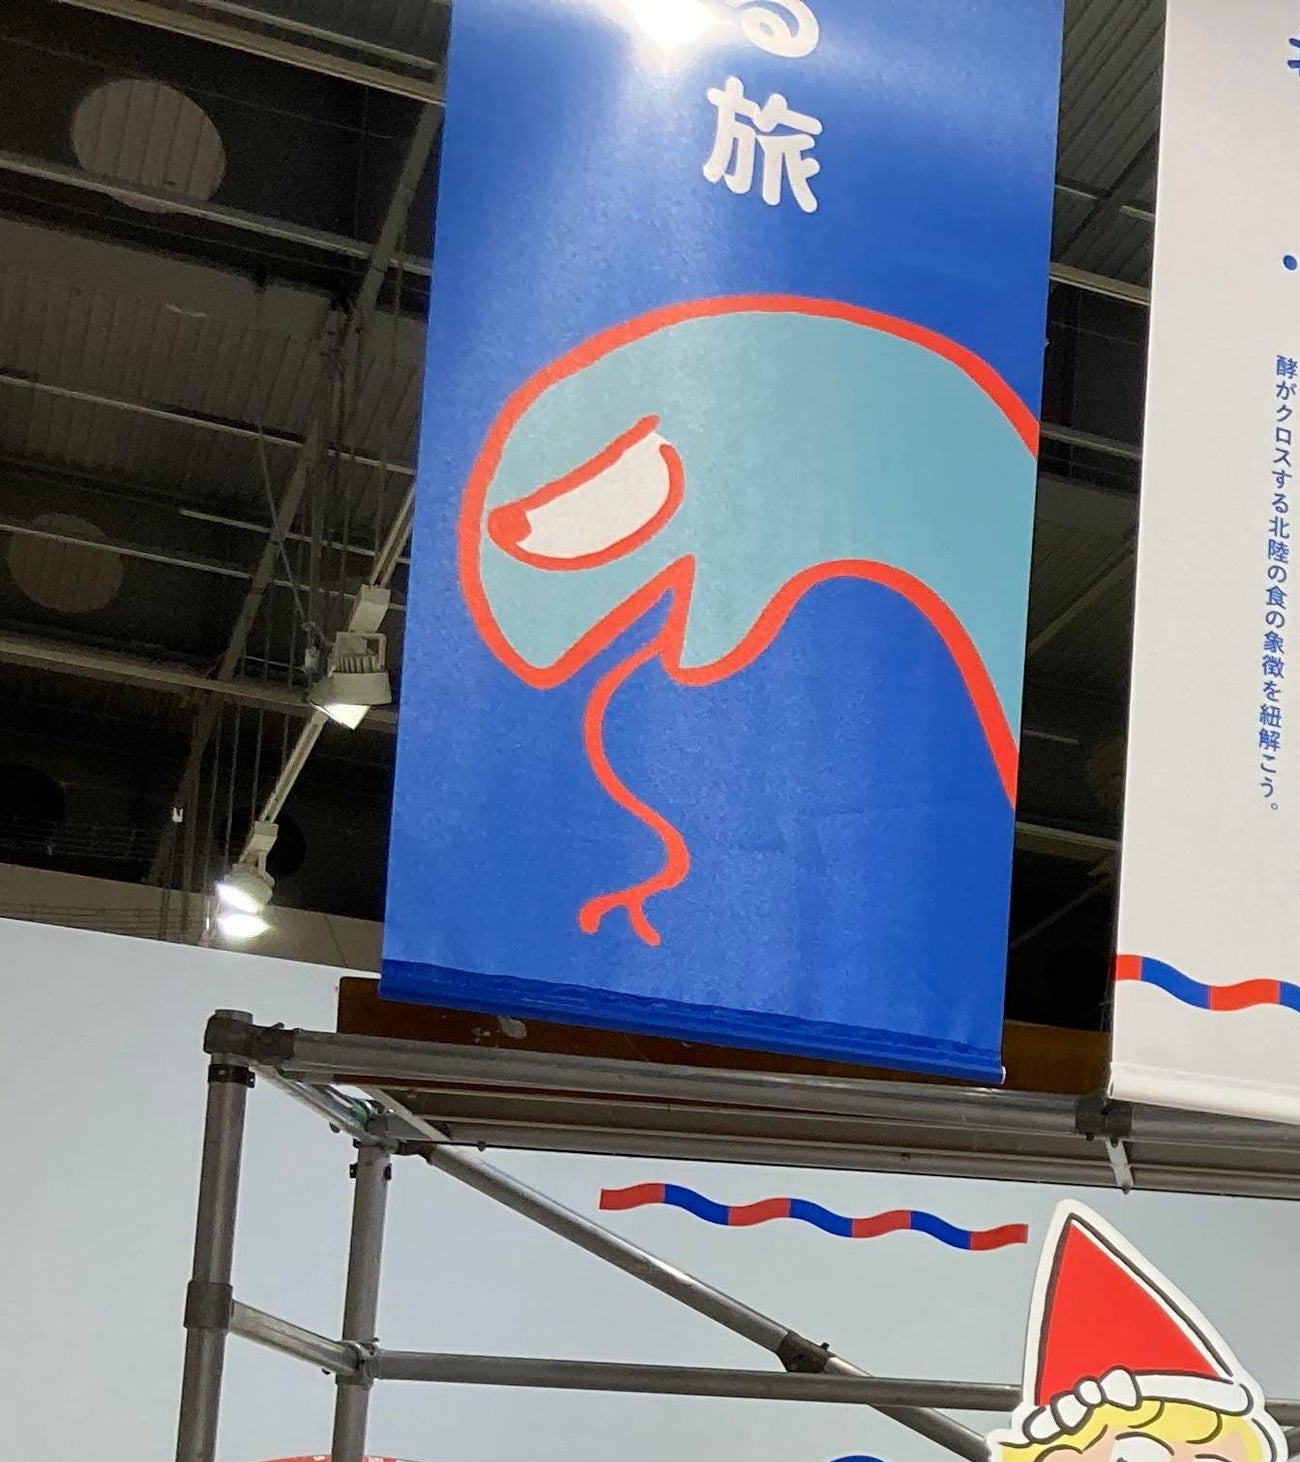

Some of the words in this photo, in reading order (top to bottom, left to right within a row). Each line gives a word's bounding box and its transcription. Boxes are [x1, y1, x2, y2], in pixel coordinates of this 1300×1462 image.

[1257, 354, 1298, 811] 酵がクロスする北陸の食の象徴を紐解こう。
